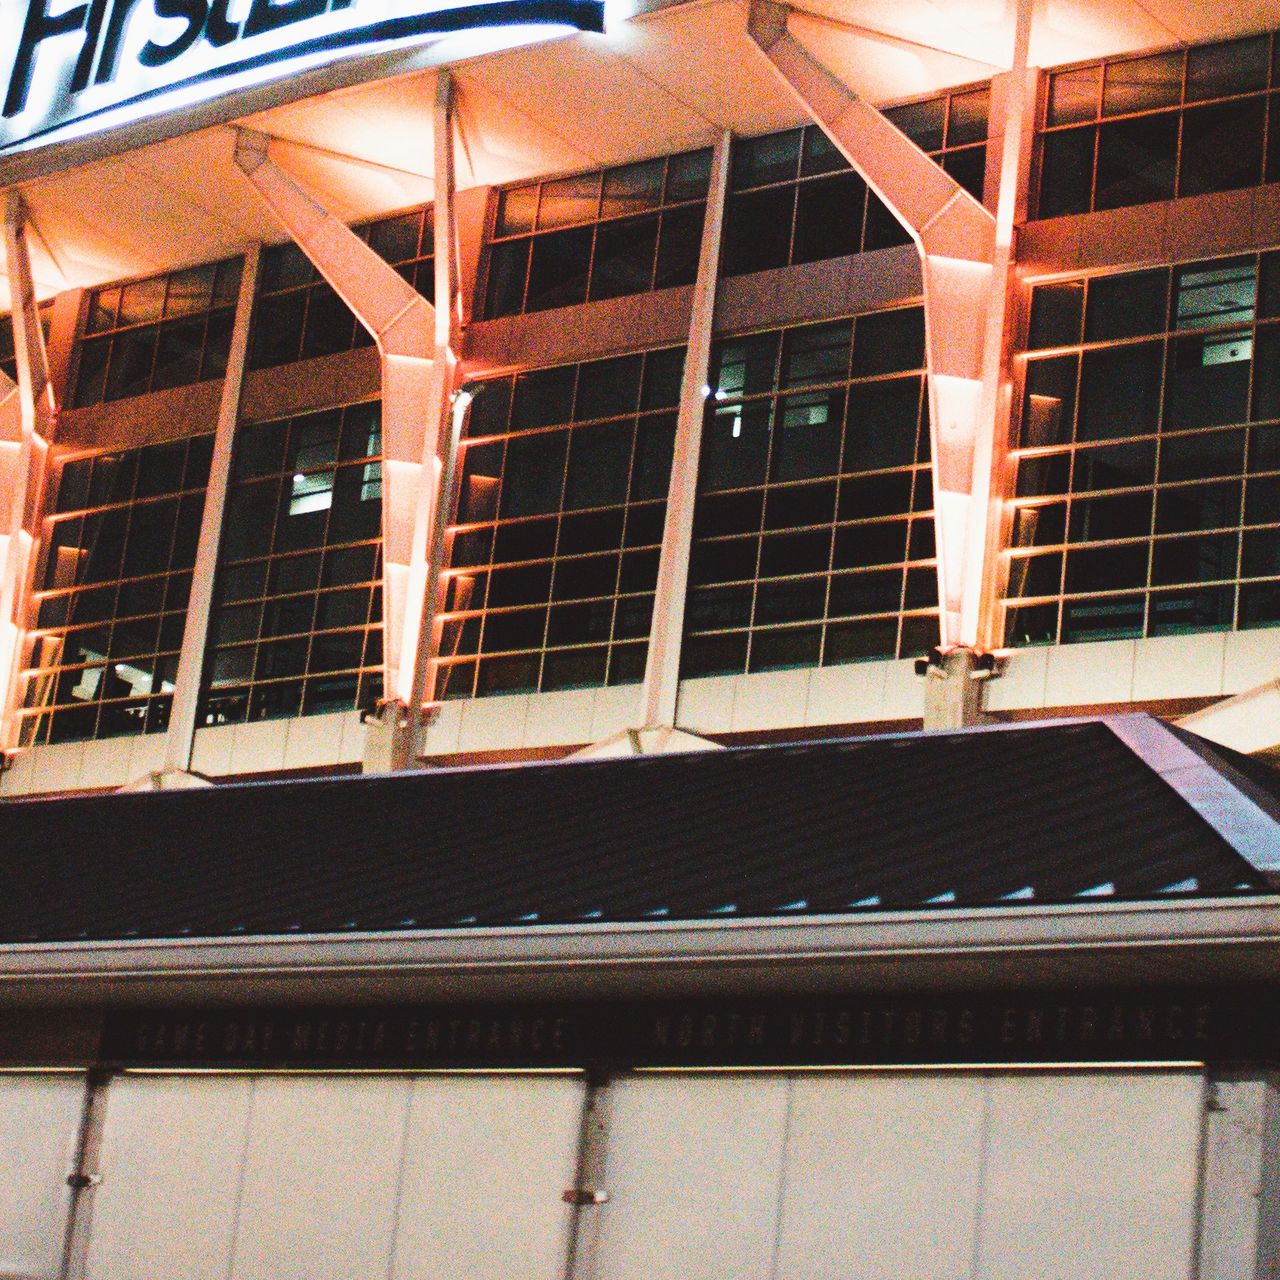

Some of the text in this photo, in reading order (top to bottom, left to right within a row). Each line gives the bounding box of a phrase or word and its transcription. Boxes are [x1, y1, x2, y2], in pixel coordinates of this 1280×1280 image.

[136, 1022, 206, 1053] GAME
[293, 1021, 386, 1052] MEDIA
[406, 1018, 565, 1052] ENTRANCE
[656, 1005, 1212, 1046] NORTH VISITORS ENTRANCE
